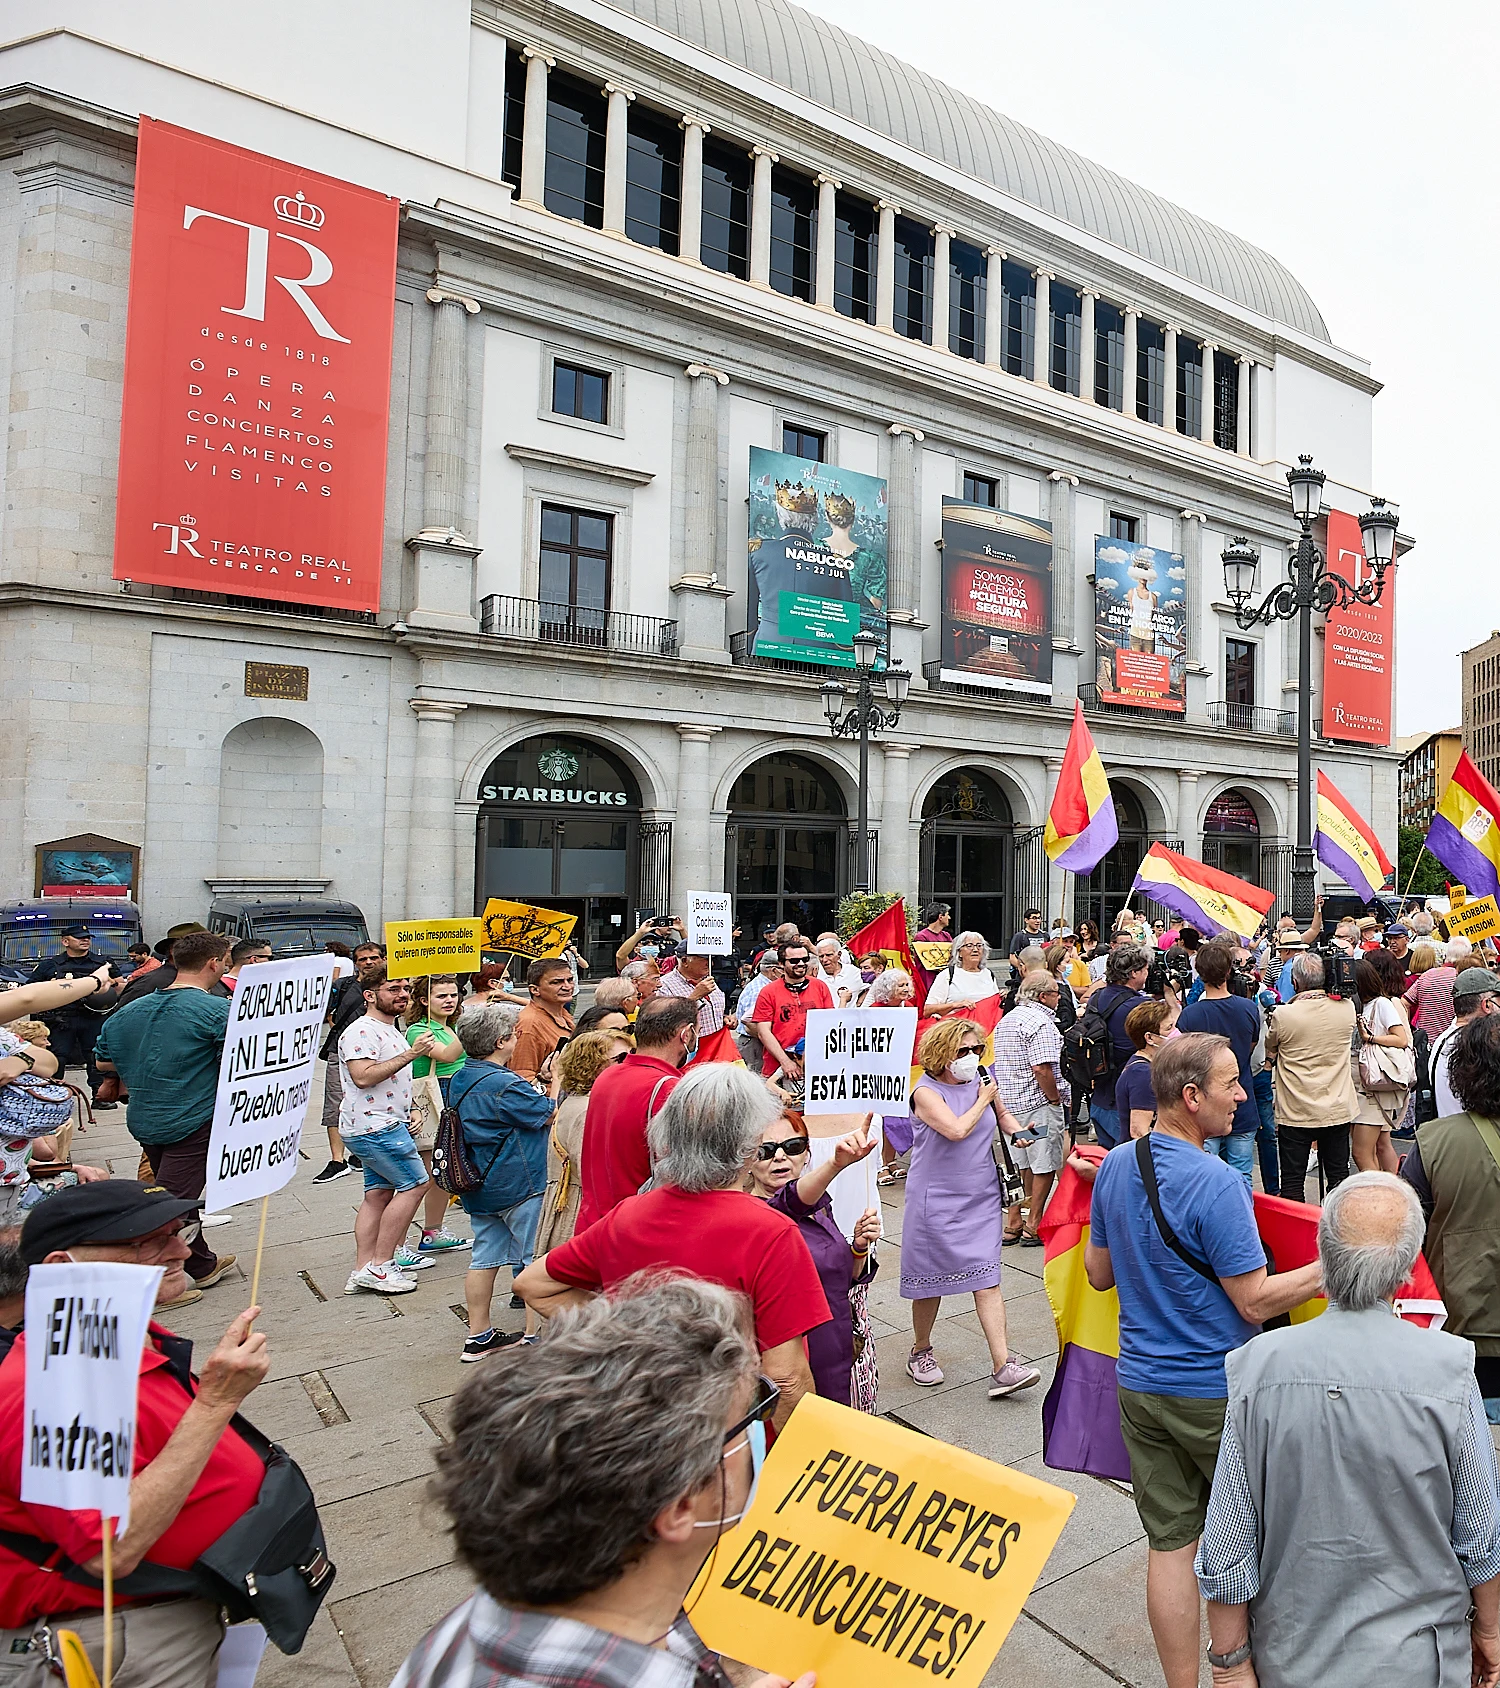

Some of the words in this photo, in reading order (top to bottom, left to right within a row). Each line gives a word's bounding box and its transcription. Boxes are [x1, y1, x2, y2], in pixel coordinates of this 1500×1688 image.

[201, 327, 268, 351] desde
[284, 346, 330, 366] 1818
[190, 357, 336, 402] ÓPERA
[188, 384, 335, 426] DANZA
[187, 410, 334, 449] CONCIERTOS
[186, 434, 333, 473] FLAMENCO
[184, 459, 331, 497] VISITAS
[210, 540, 292, 562] TEATRO
[301, 554, 352, 572] REAL
[785, 547, 855, 570] NABUCCO
[209, 557, 279, 574] CERCA
[295, 570, 318, 580] DE
[333, 575, 351, 585] TI
[796, 562, 802, 571] 5
[813, 565, 825, 575] 22
[828, 569, 845, 579] JUL
[974, 569, 1014, 587] SOMOS
[1016, 578, 1025, 588] Y
[969, 589, 1029, 610] #CULTURA
[972, 579, 1026, 599] HACEMOS
[975, 601, 1023, 619] SEGURA
[1108, 605, 1136, 618] JUANA
[1152, 613, 1175, 626] ARCO
[1135, 620, 1176, 635] HOGUERA
[1336, 624, 1383, 645] 2020/2023
[268, 677, 285, 685] DE
[1346, 713, 1368, 723] TEATRO
[1368, 717, 1383, 725] REAL
[483, 785, 628, 806] STARBUCKS
[695, 915, 725, 928] Cochinos
[1449, 915, 1462, 929] ¡EL
[1460, 902, 1494, 921] BORBÓN,
[1464, 917, 1496, 937] PRISIÓN!
[397, 930, 413, 943] Sólo
[414, 930, 425, 941] los
[425, 928, 473, 941] irresponsables
[695, 933, 724, 946] ladrones.
[394, 947, 419, 961] quieren
[420, 946, 436, 958] reyes
[437, 946, 456, 955] como
[457, 943, 475, 954] ellos.
[237, 980, 293, 1021] BURLAR
[296, 978, 308, 1013] LA
[308, 975, 329, 1013] LEY,
[227, 1034, 258, 1083] ¡NI
[264, 1030, 289, 1067] EL
[292, 1022, 320, 1062] REY!
[825, 1022, 847, 1060] ¡SÍ!
[851, 1027, 870, 1059] ¡EL
[871, 1027, 895, 1053] REY
[810, 1068, 847, 1101] ESTÁ
[851, 1073, 906, 1102] DESNUDO!
[229, 1082, 285, 1127] "Pueblo
[218, 1144, 262, 1181] buen
[42, 1297, 75, 1371] ¡El
[30, 1409, 51, 1468] ha
[774, 1449, 919, 1539] ¡FUERA
[901, 1490, 1021, 1580] REYES
[720, 1529, 987, 1680] DELINCUENTES!
